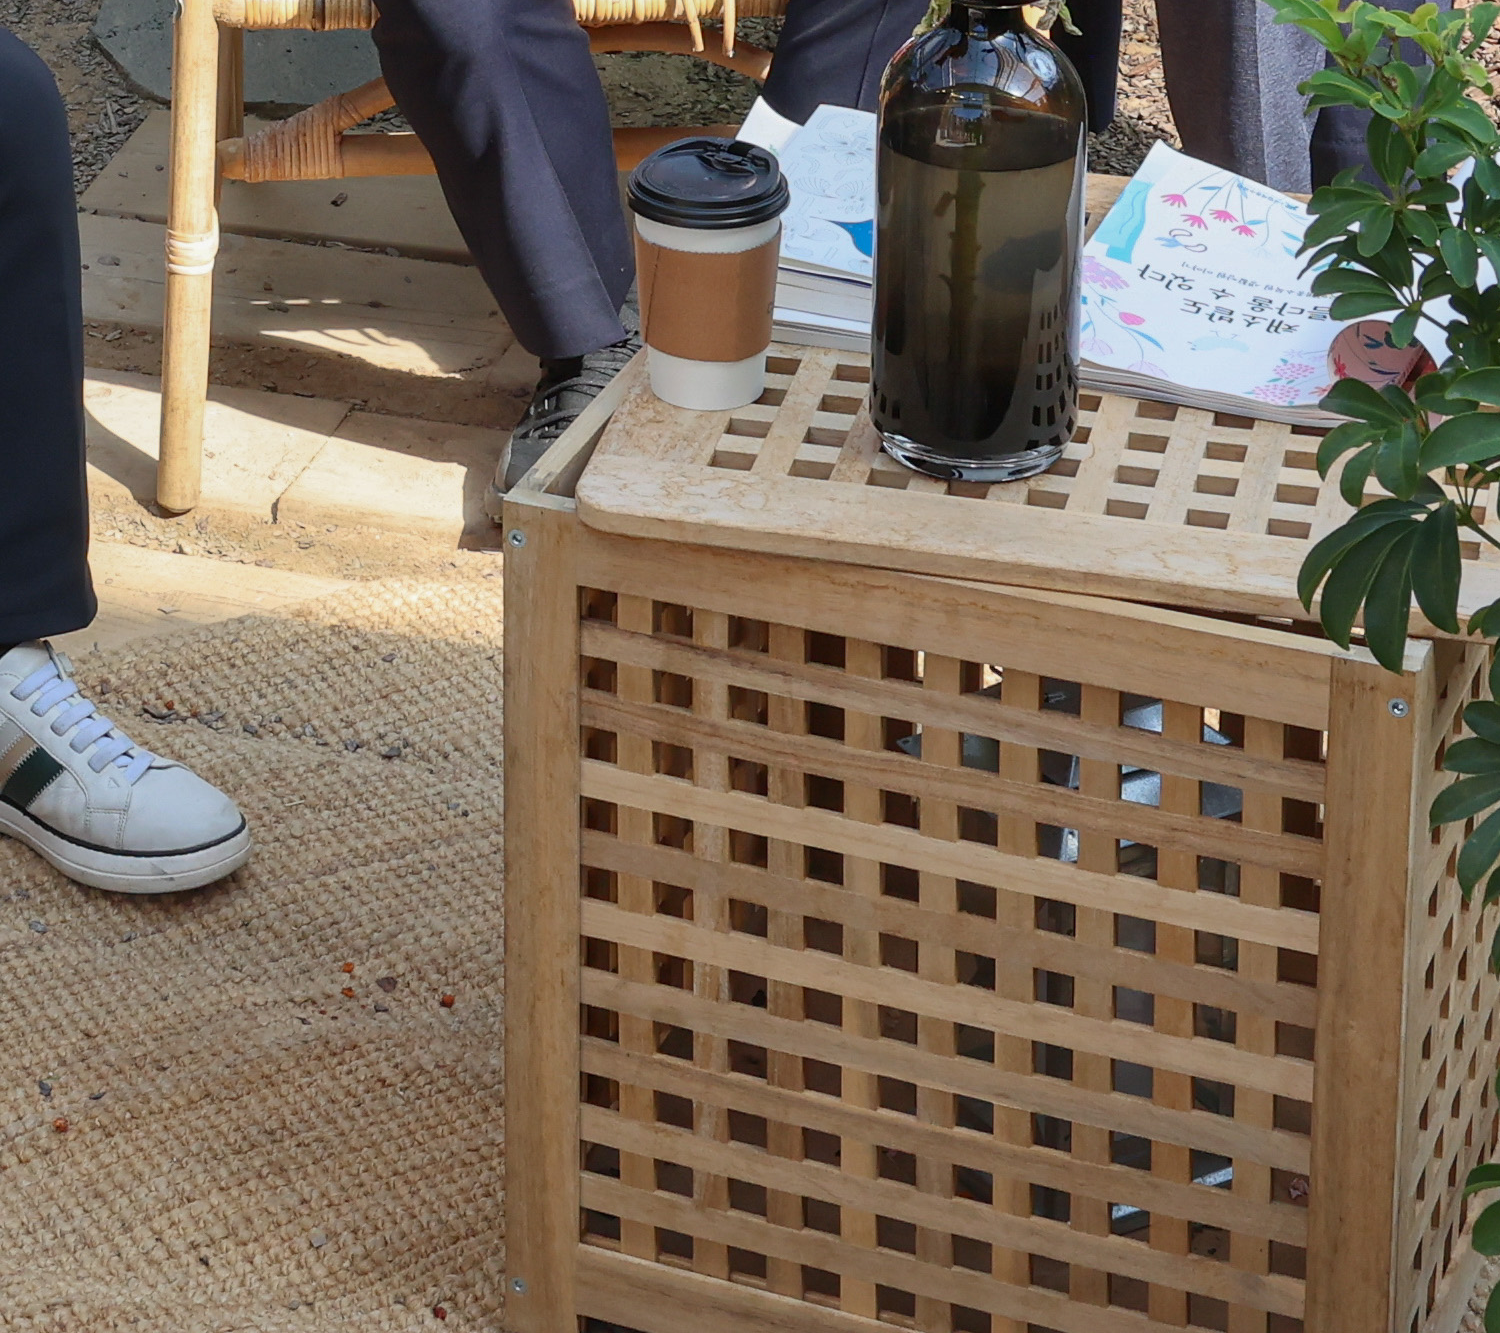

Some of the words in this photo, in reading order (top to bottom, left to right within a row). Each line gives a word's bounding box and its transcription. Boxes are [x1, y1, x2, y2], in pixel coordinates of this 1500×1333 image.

[1136, 264, 1196, 292] 있다
[1209, 287, 1235, 300] 수
[1247, 295, 1331, 322] 름다울
